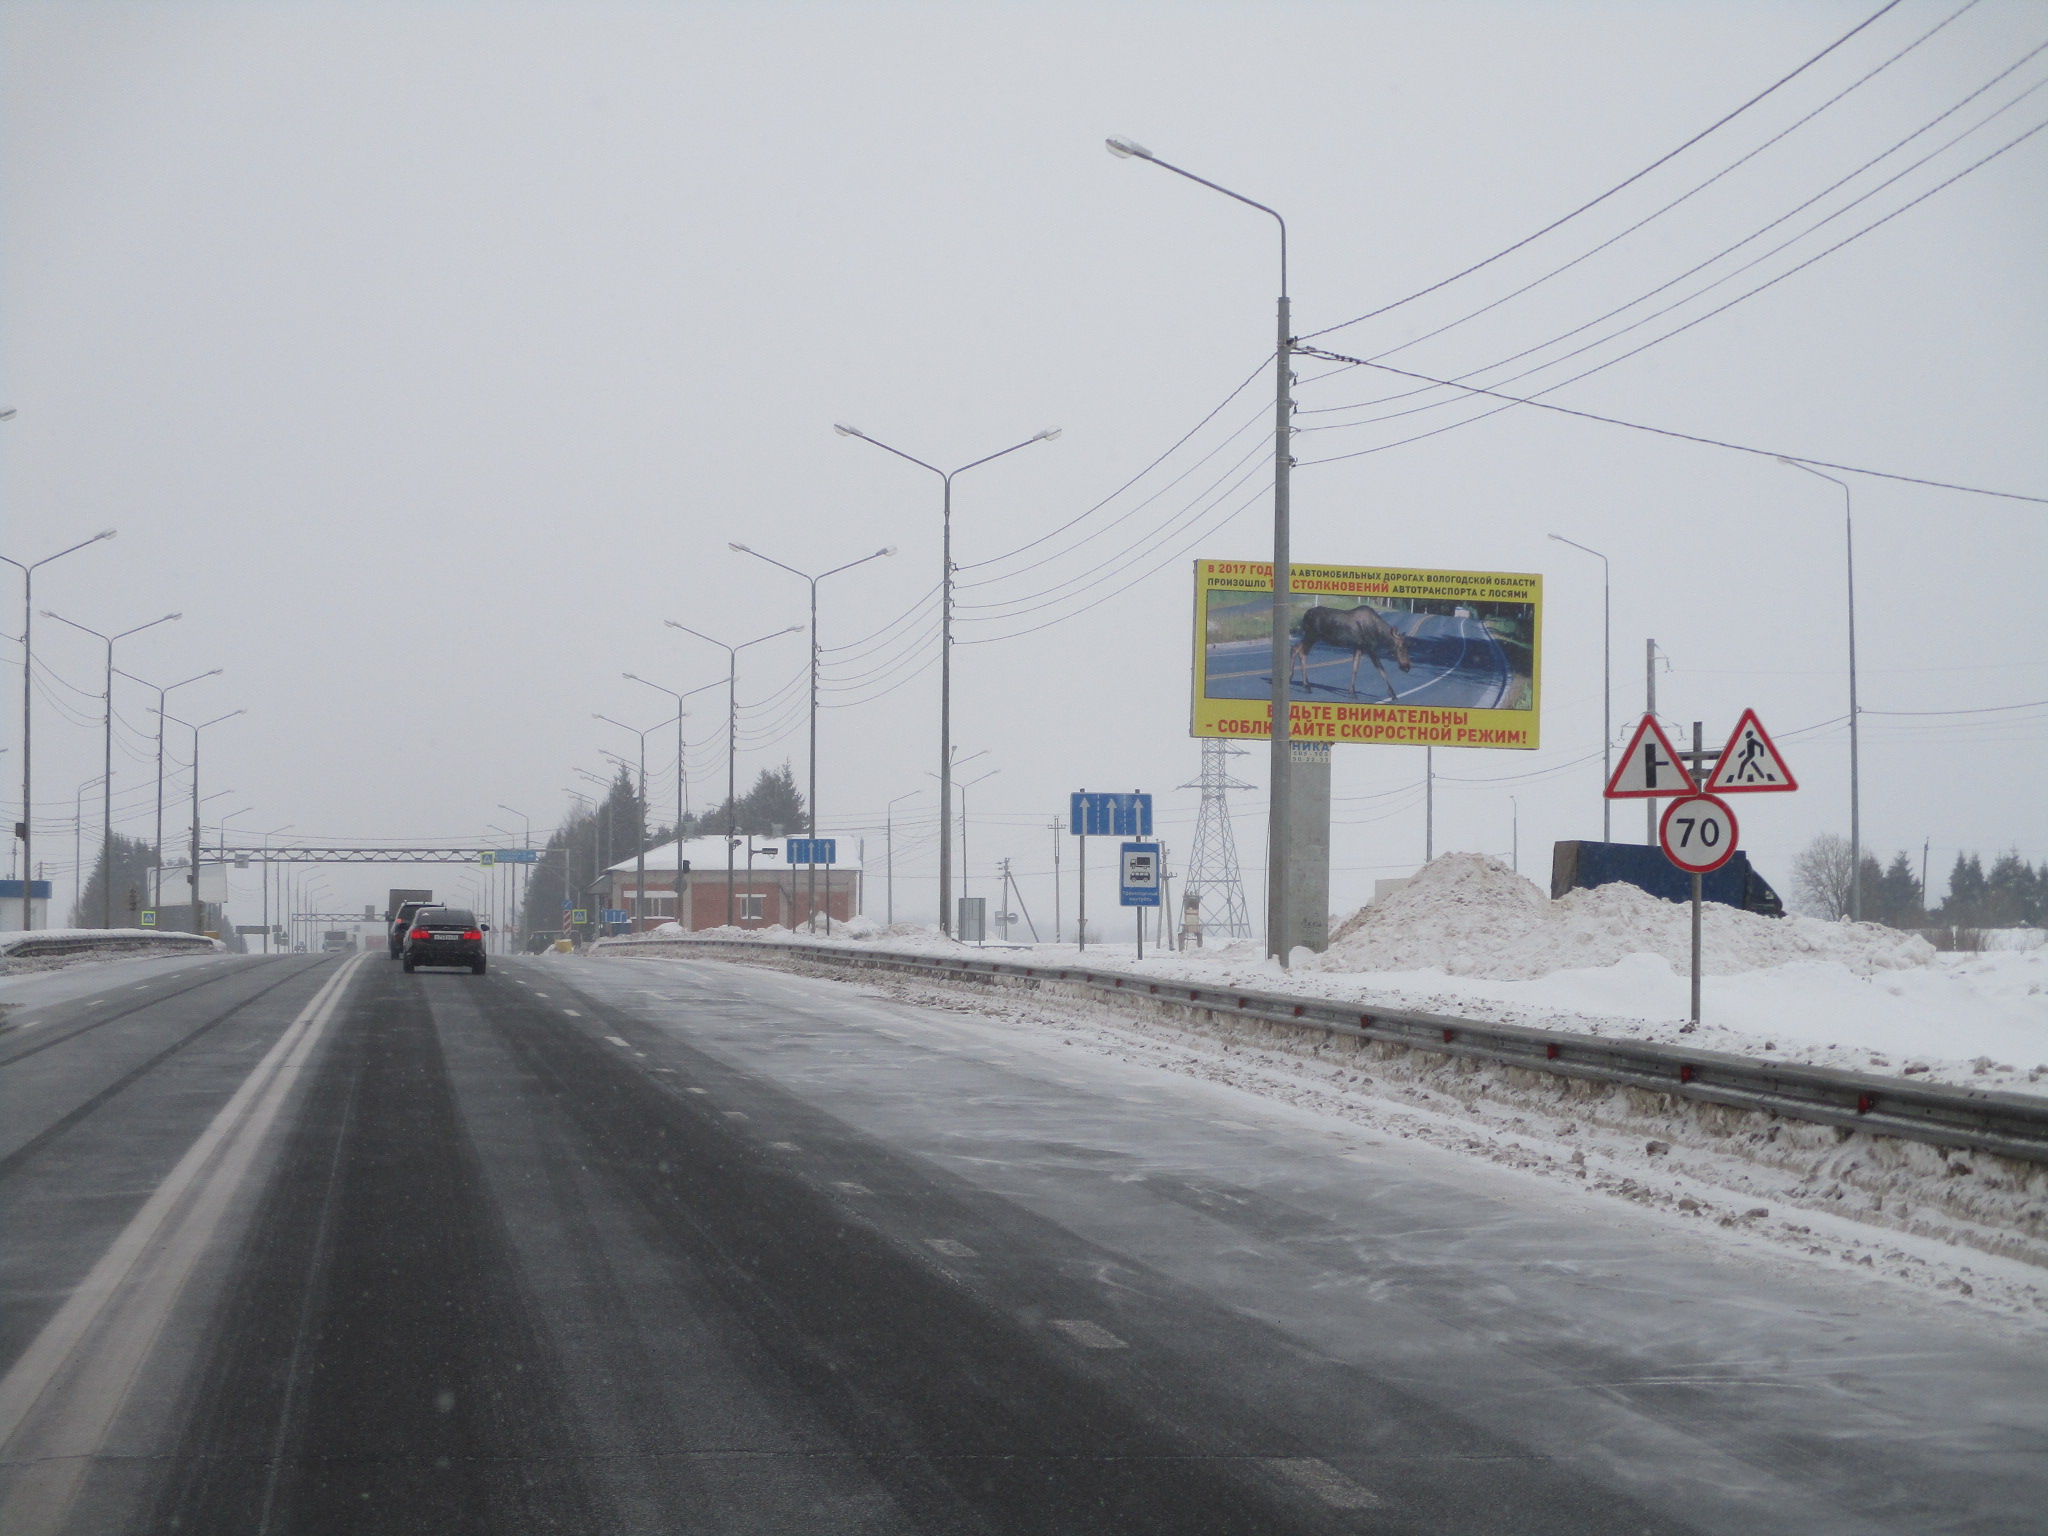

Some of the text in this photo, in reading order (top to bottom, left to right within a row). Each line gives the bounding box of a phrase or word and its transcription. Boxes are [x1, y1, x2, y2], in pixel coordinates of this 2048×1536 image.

[1219, 564, 1246, 574] 2017
[1250, 565, 1274, 577] ГОД
[1299, 569, 1381, 580] АВТОМОБИЛЬНЫХ
[1383, 572, 1424, 583] ДОРОГАХ
[1427, 574, 1492, 585] ВОЛОГОДСКОЙ
[1494, 578, 1536, 587] ОБЛАСТИ
[1208, 578, 1266, 588] ПРОИЗОШЛО
[1292, 578, 1389, 593] СТОЛКНОВЕНИЙ
[1392, 585, 1477, 596] АВТОТРАНСПОРТА
[1480, 588, 1486, 596] С
[1488, 588, 1528, 599] ЛОСЯМИ
[1267, 704, 1468, 725] БДЬТЕ ВНИМАТЕЛЬНЫ
[1218, 719, 1336, 737] СОБЛЮАЙТЕ
[1341, 723, 1452, 741] СКОРОСТНОЙ
[1457, 728, 1528, 744] РЕЖИМ!
[1292, 742, 1329, 751] НИКА
[1676, 818, 1719, 848] 70
